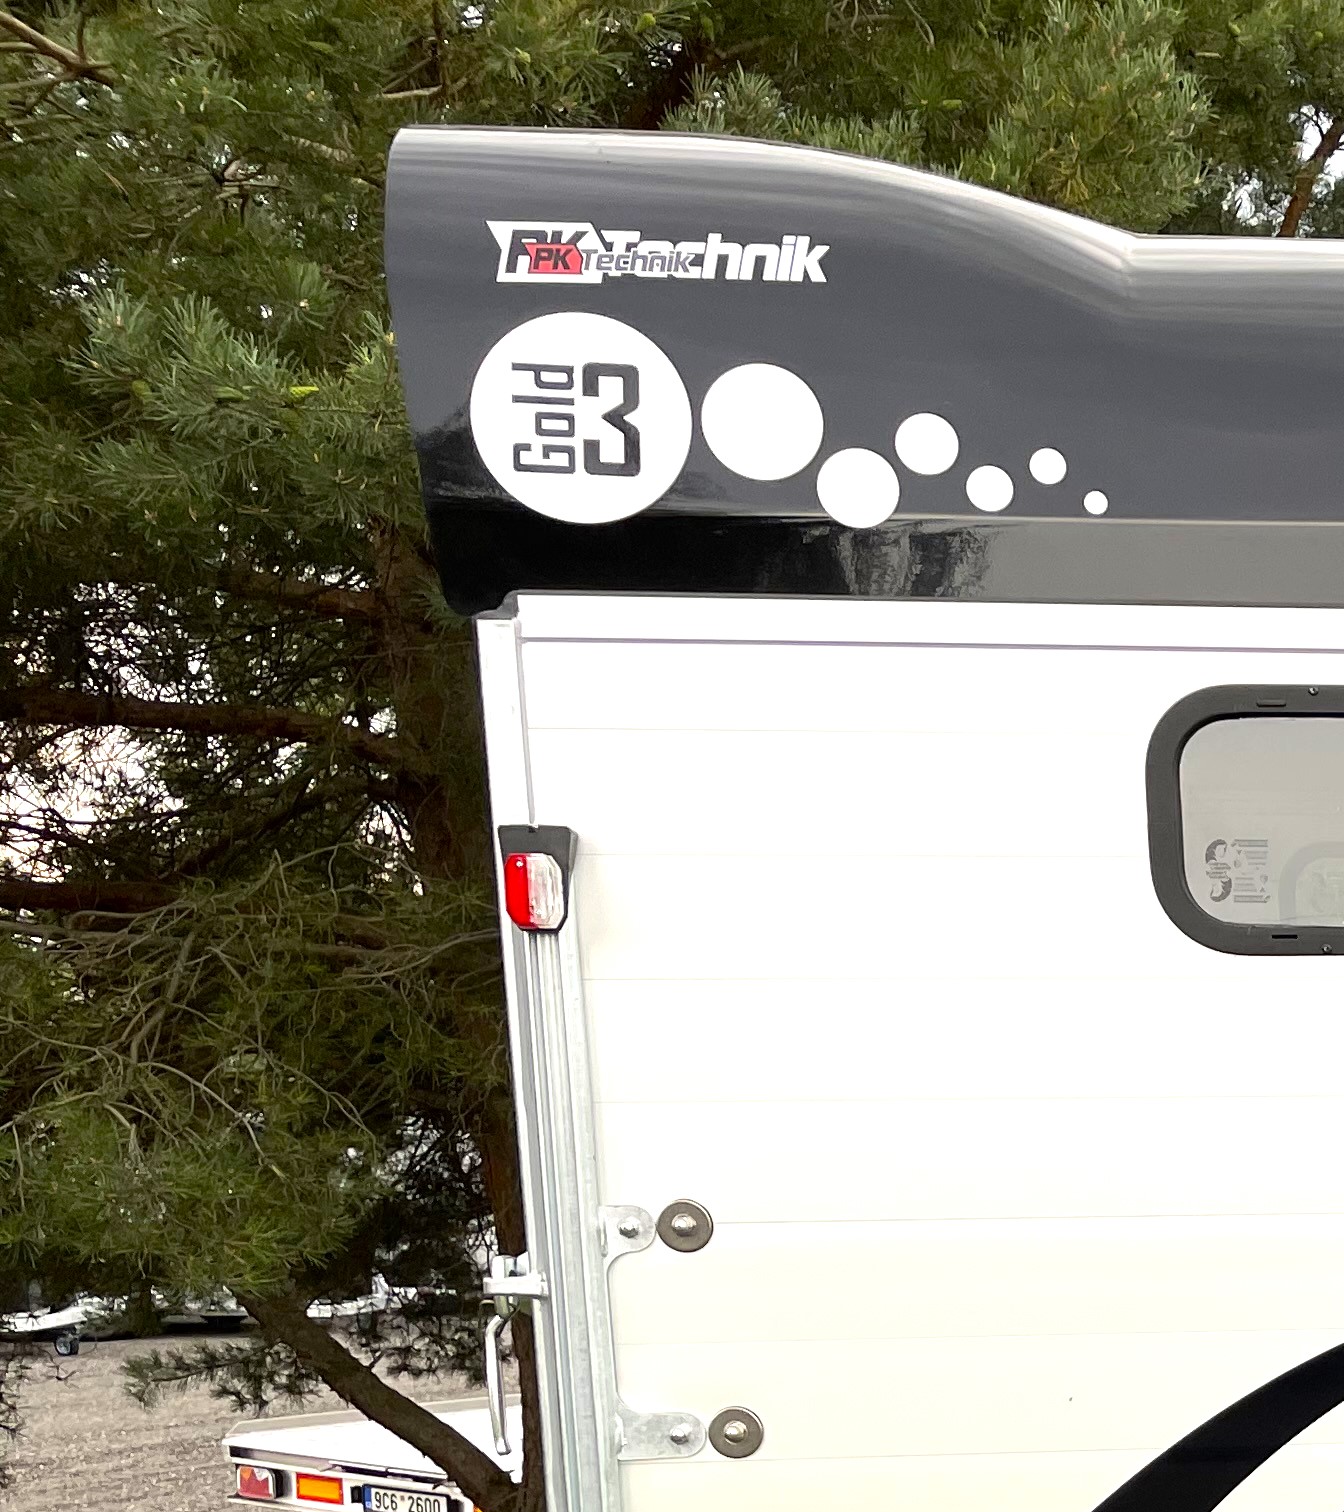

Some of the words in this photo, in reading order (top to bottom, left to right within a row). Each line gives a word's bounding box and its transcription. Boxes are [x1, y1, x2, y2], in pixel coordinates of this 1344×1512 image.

[533, 247, 574, 271] PK
[580, 247, 692, 274] Technik
[511, 362, 576, 475] Gold
[582, 362, 641, 477] 3
[374, 1491, 398, 1511] 9C6
